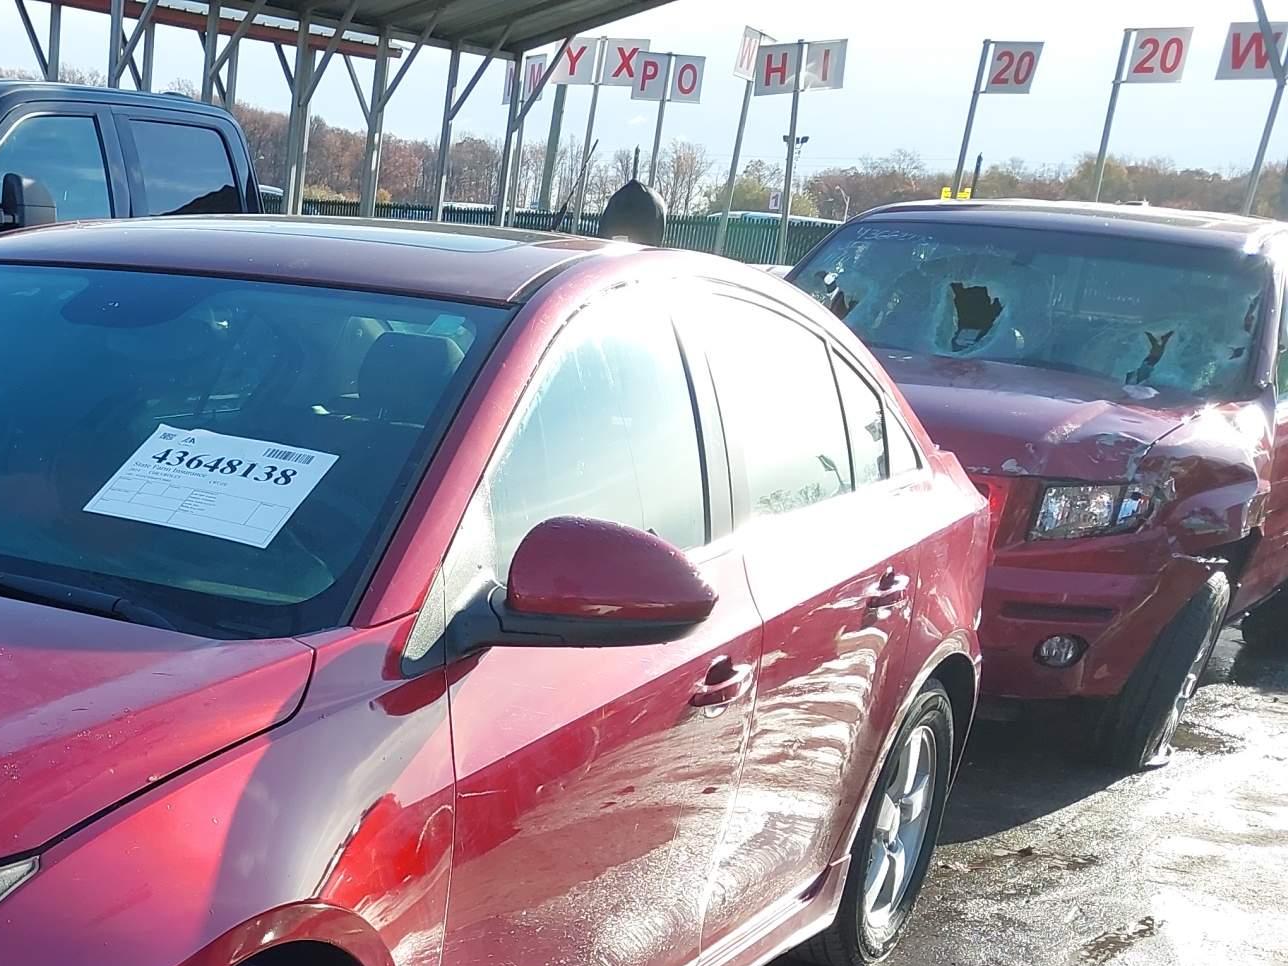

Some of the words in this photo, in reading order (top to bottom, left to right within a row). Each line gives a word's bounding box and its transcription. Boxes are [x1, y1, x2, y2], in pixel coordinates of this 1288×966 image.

[566, 46, 588, 76] Y
[612, 47, 640, 78] X
[764, 52, 788, 86] H
[821, 49, 830, 81] I
[991, 50, 1035, 85] 20
[1132, 37, 1183, 74] 20
[1231, 32, 1283, 70] W
[639, 60, 659, 91] P
[677, 63, 698, 95] O
[152, 448, 298, 486] 43648138
